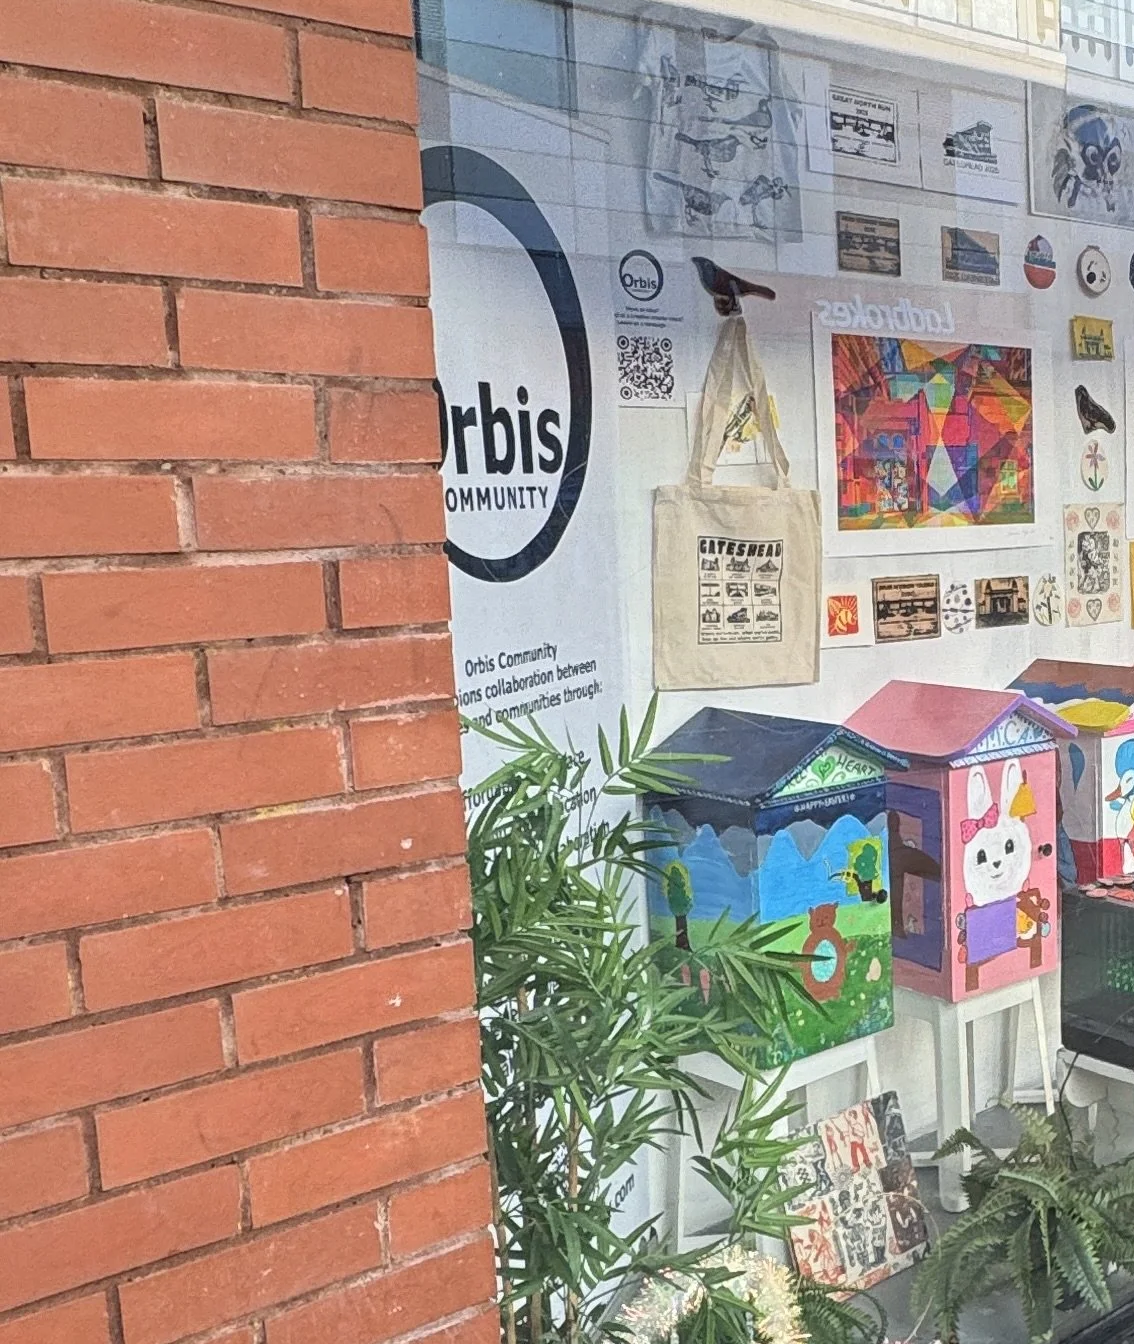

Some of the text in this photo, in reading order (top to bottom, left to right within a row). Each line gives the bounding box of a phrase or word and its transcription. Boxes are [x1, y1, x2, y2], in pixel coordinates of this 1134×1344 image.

[622, 273, 657, 290] Orbis
[432, 378, 564, 475] rbis
[445, 486, 548, 512] OMMUNITY
[700, 539, 782, 557] GATESHEAD
[465, 642, 557, 677] Orbis Community
[456, 659, 596, 707] ions collaboration between
[472, 708, 492, 728] and
[496, 691, 561, 723] communities
[564, 679, 602, 702] through:
